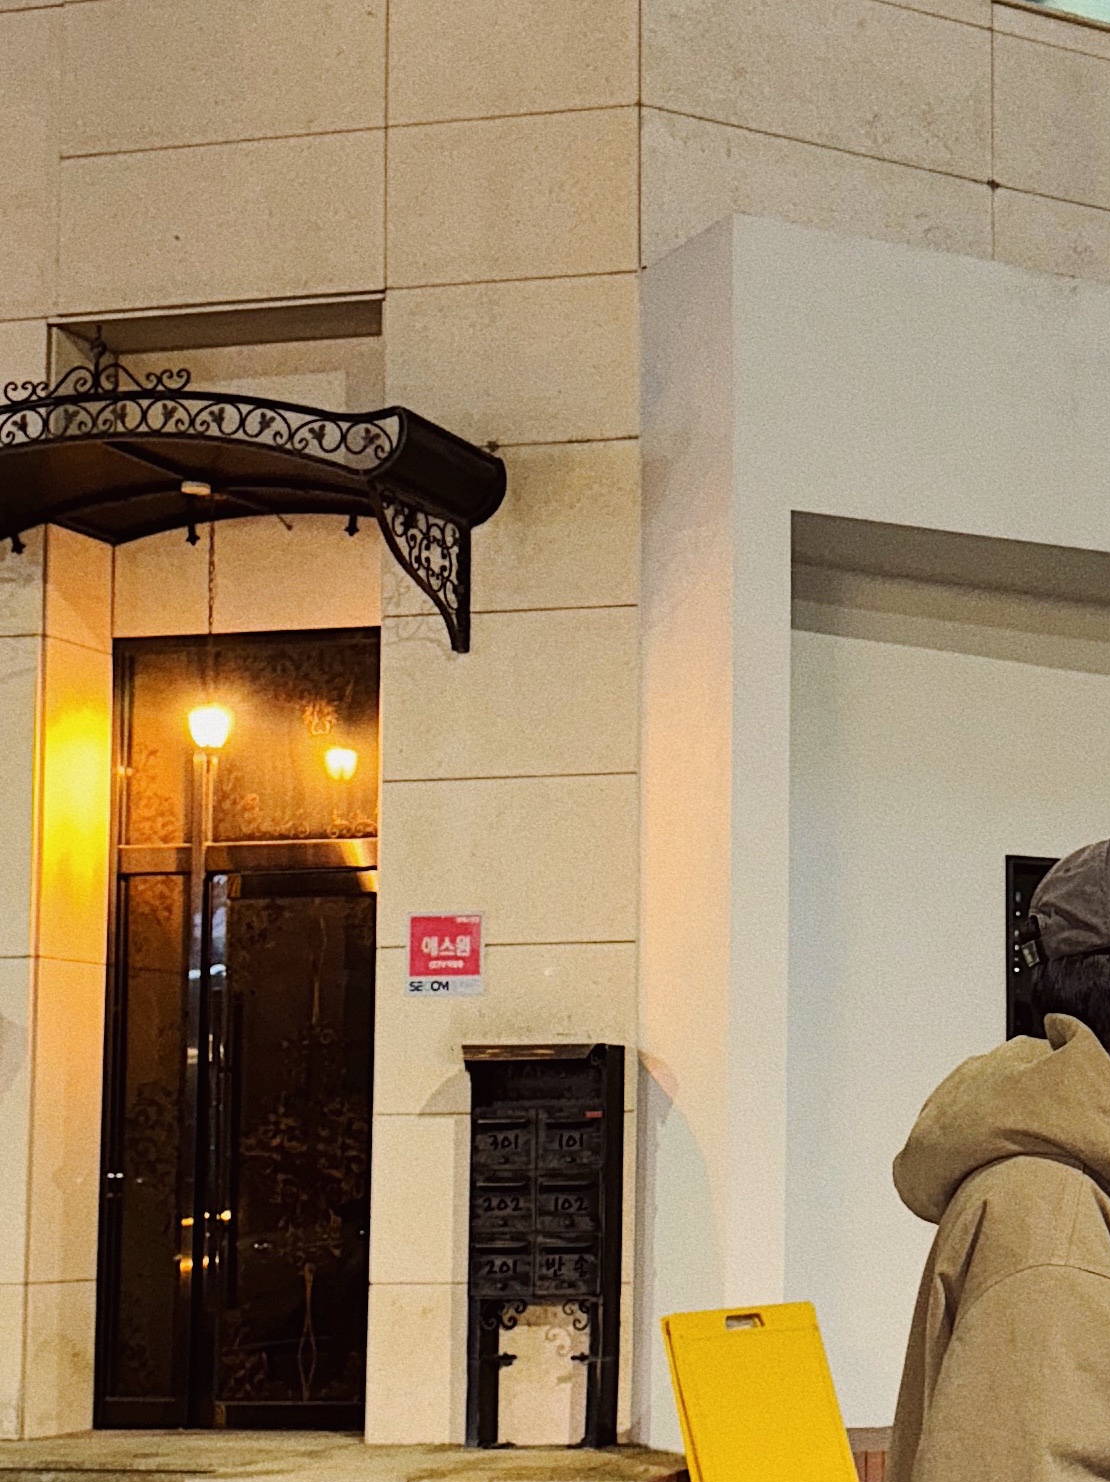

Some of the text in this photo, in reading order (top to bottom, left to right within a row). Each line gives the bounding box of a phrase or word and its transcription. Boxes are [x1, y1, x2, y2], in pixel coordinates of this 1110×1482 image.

[488, 1133, 520, 1151] 301
[558, 1132, 584, 1150] 101
[482, 1196, 523, 1213] 202
[553, 1196, 588, 1212] 102
[484, 1259, 518, 1276] 201
